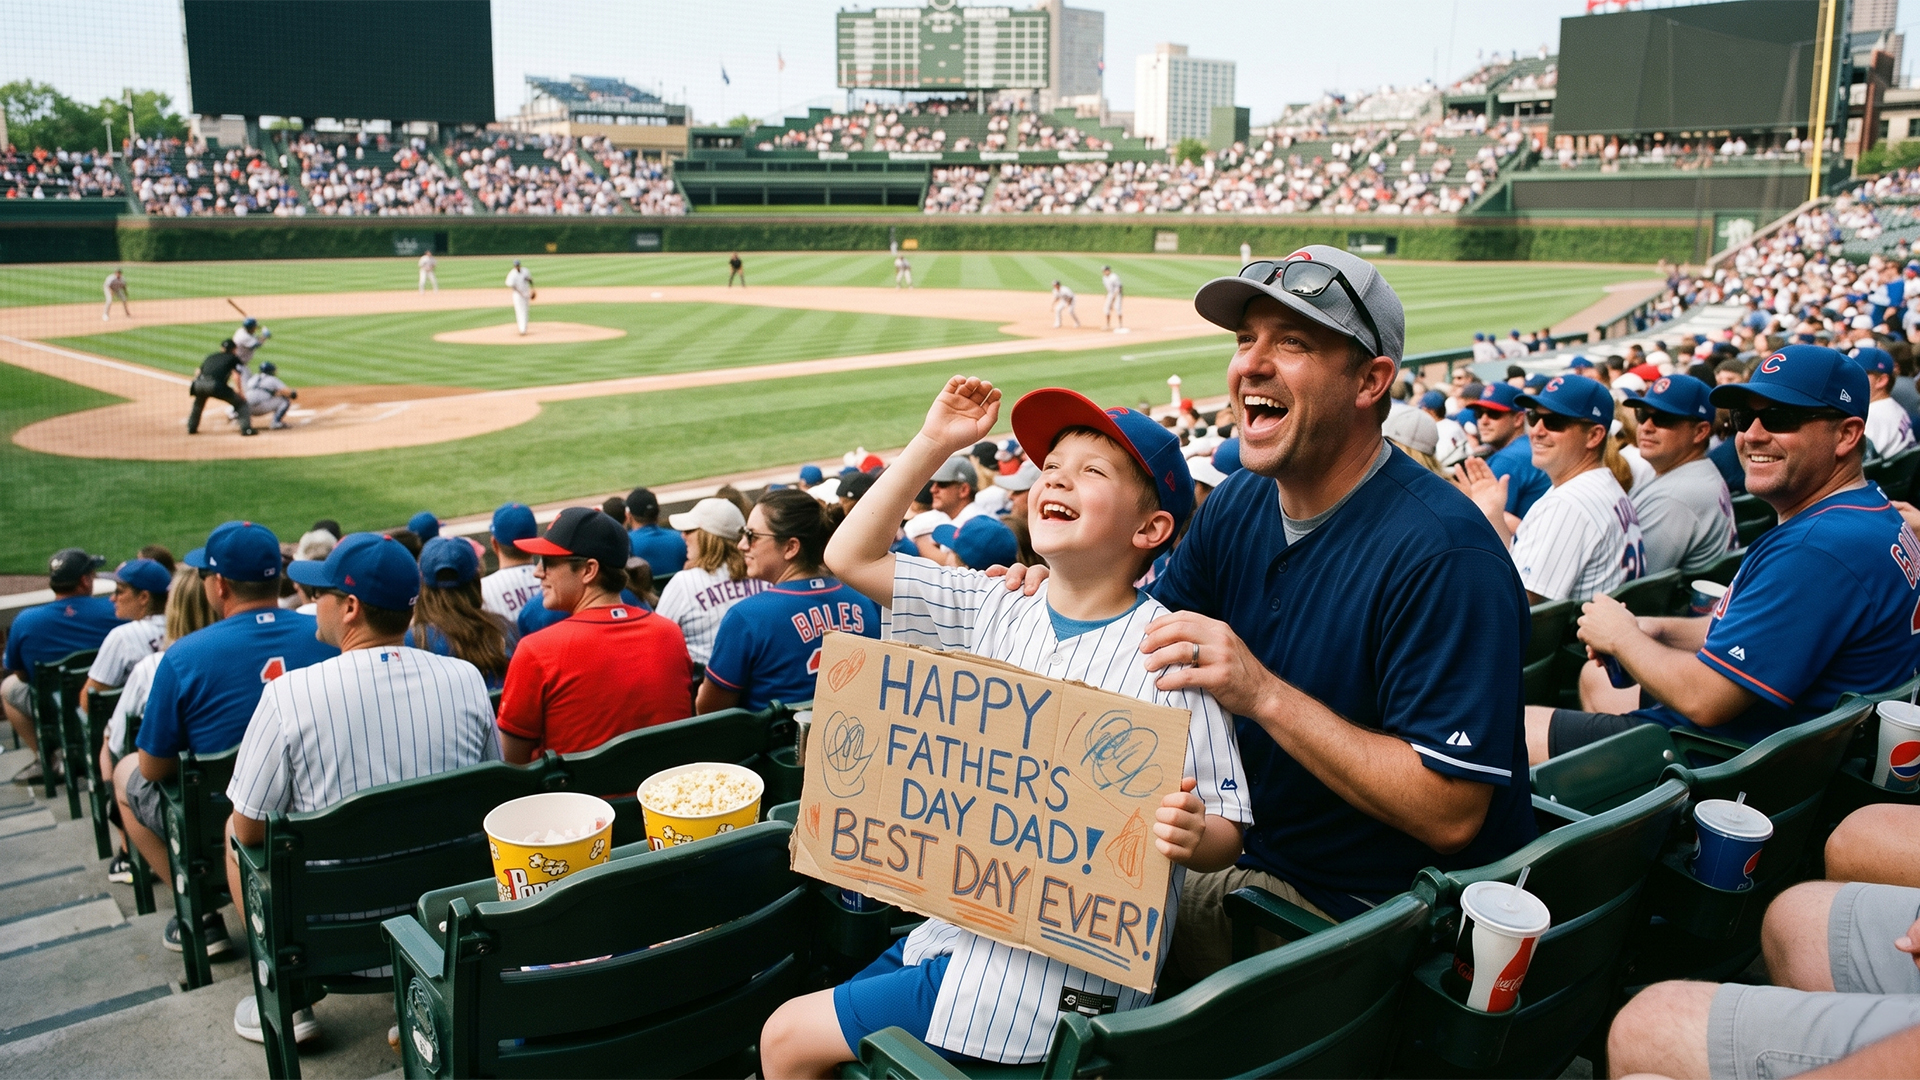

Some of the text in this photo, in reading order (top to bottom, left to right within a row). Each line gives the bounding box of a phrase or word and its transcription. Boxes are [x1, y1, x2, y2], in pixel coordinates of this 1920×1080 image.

[1546, 376, 1565, 393] C
[1761, 353, 1786, 374] C
[791, 602, 865, 643] BALES
[879, 654, 1053, 750] HAPPY
[887, 723, 1071, 812] FATHER'S
[900, 777, 1105, 875] DAY DAD!
[831, 807, 1160, 961] BEST DAY EVER!
